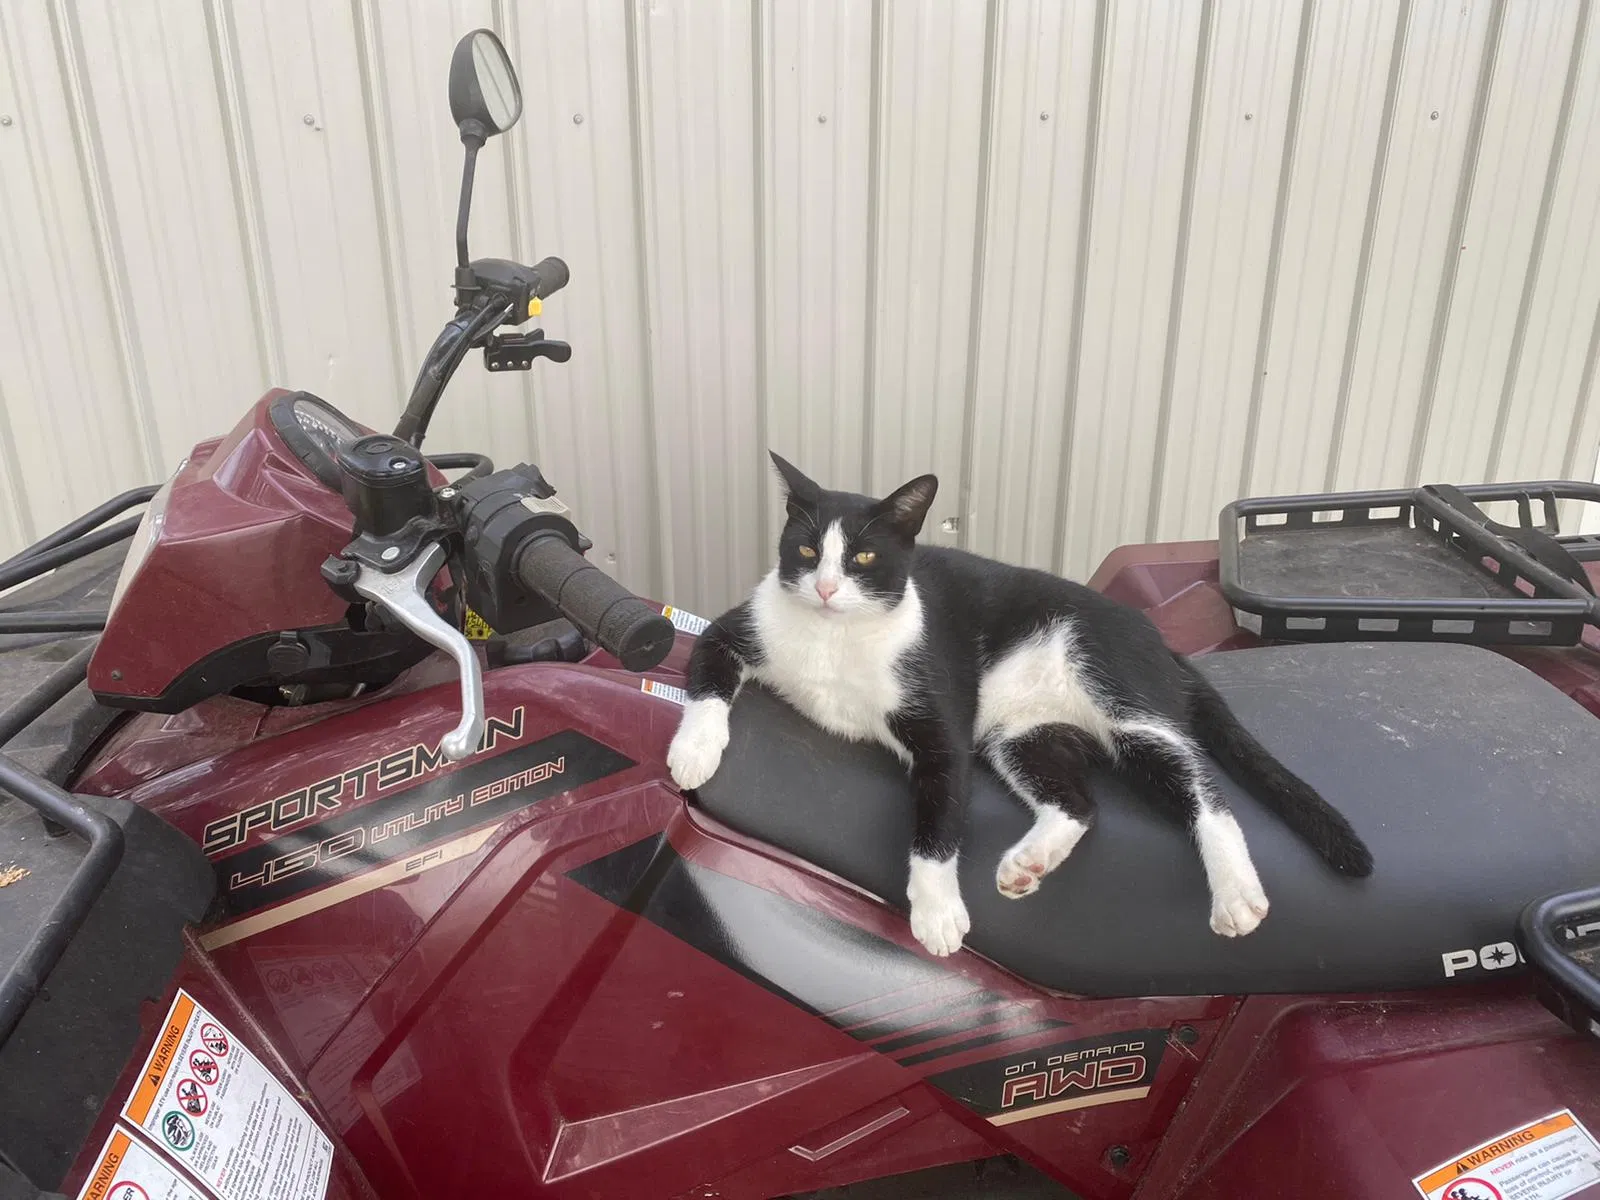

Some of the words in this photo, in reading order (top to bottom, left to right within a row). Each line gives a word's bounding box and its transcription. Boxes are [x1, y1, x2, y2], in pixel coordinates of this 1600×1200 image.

[202, 706, 524, 856] SPORTSMN
[231, 827, 365, 890] 450
[371, 794, 464, 844] UTILITY
[471, 757, 565, 806] EDITION
[406, 849, 443, 871] EFI
[154, 1026, 180, 1071] WARNING
[1004, 1061, 1036, 1076] ON
[1047, 1041, 1144, 1066] DEMAND
[1001, 1055, 1147, 1108] AWD
[1467, 1130, 1536, 1166] WARNING
[1490, 1160, 1515, 1175] NEVER
[89, 1152, 119, 1200] ARNING
